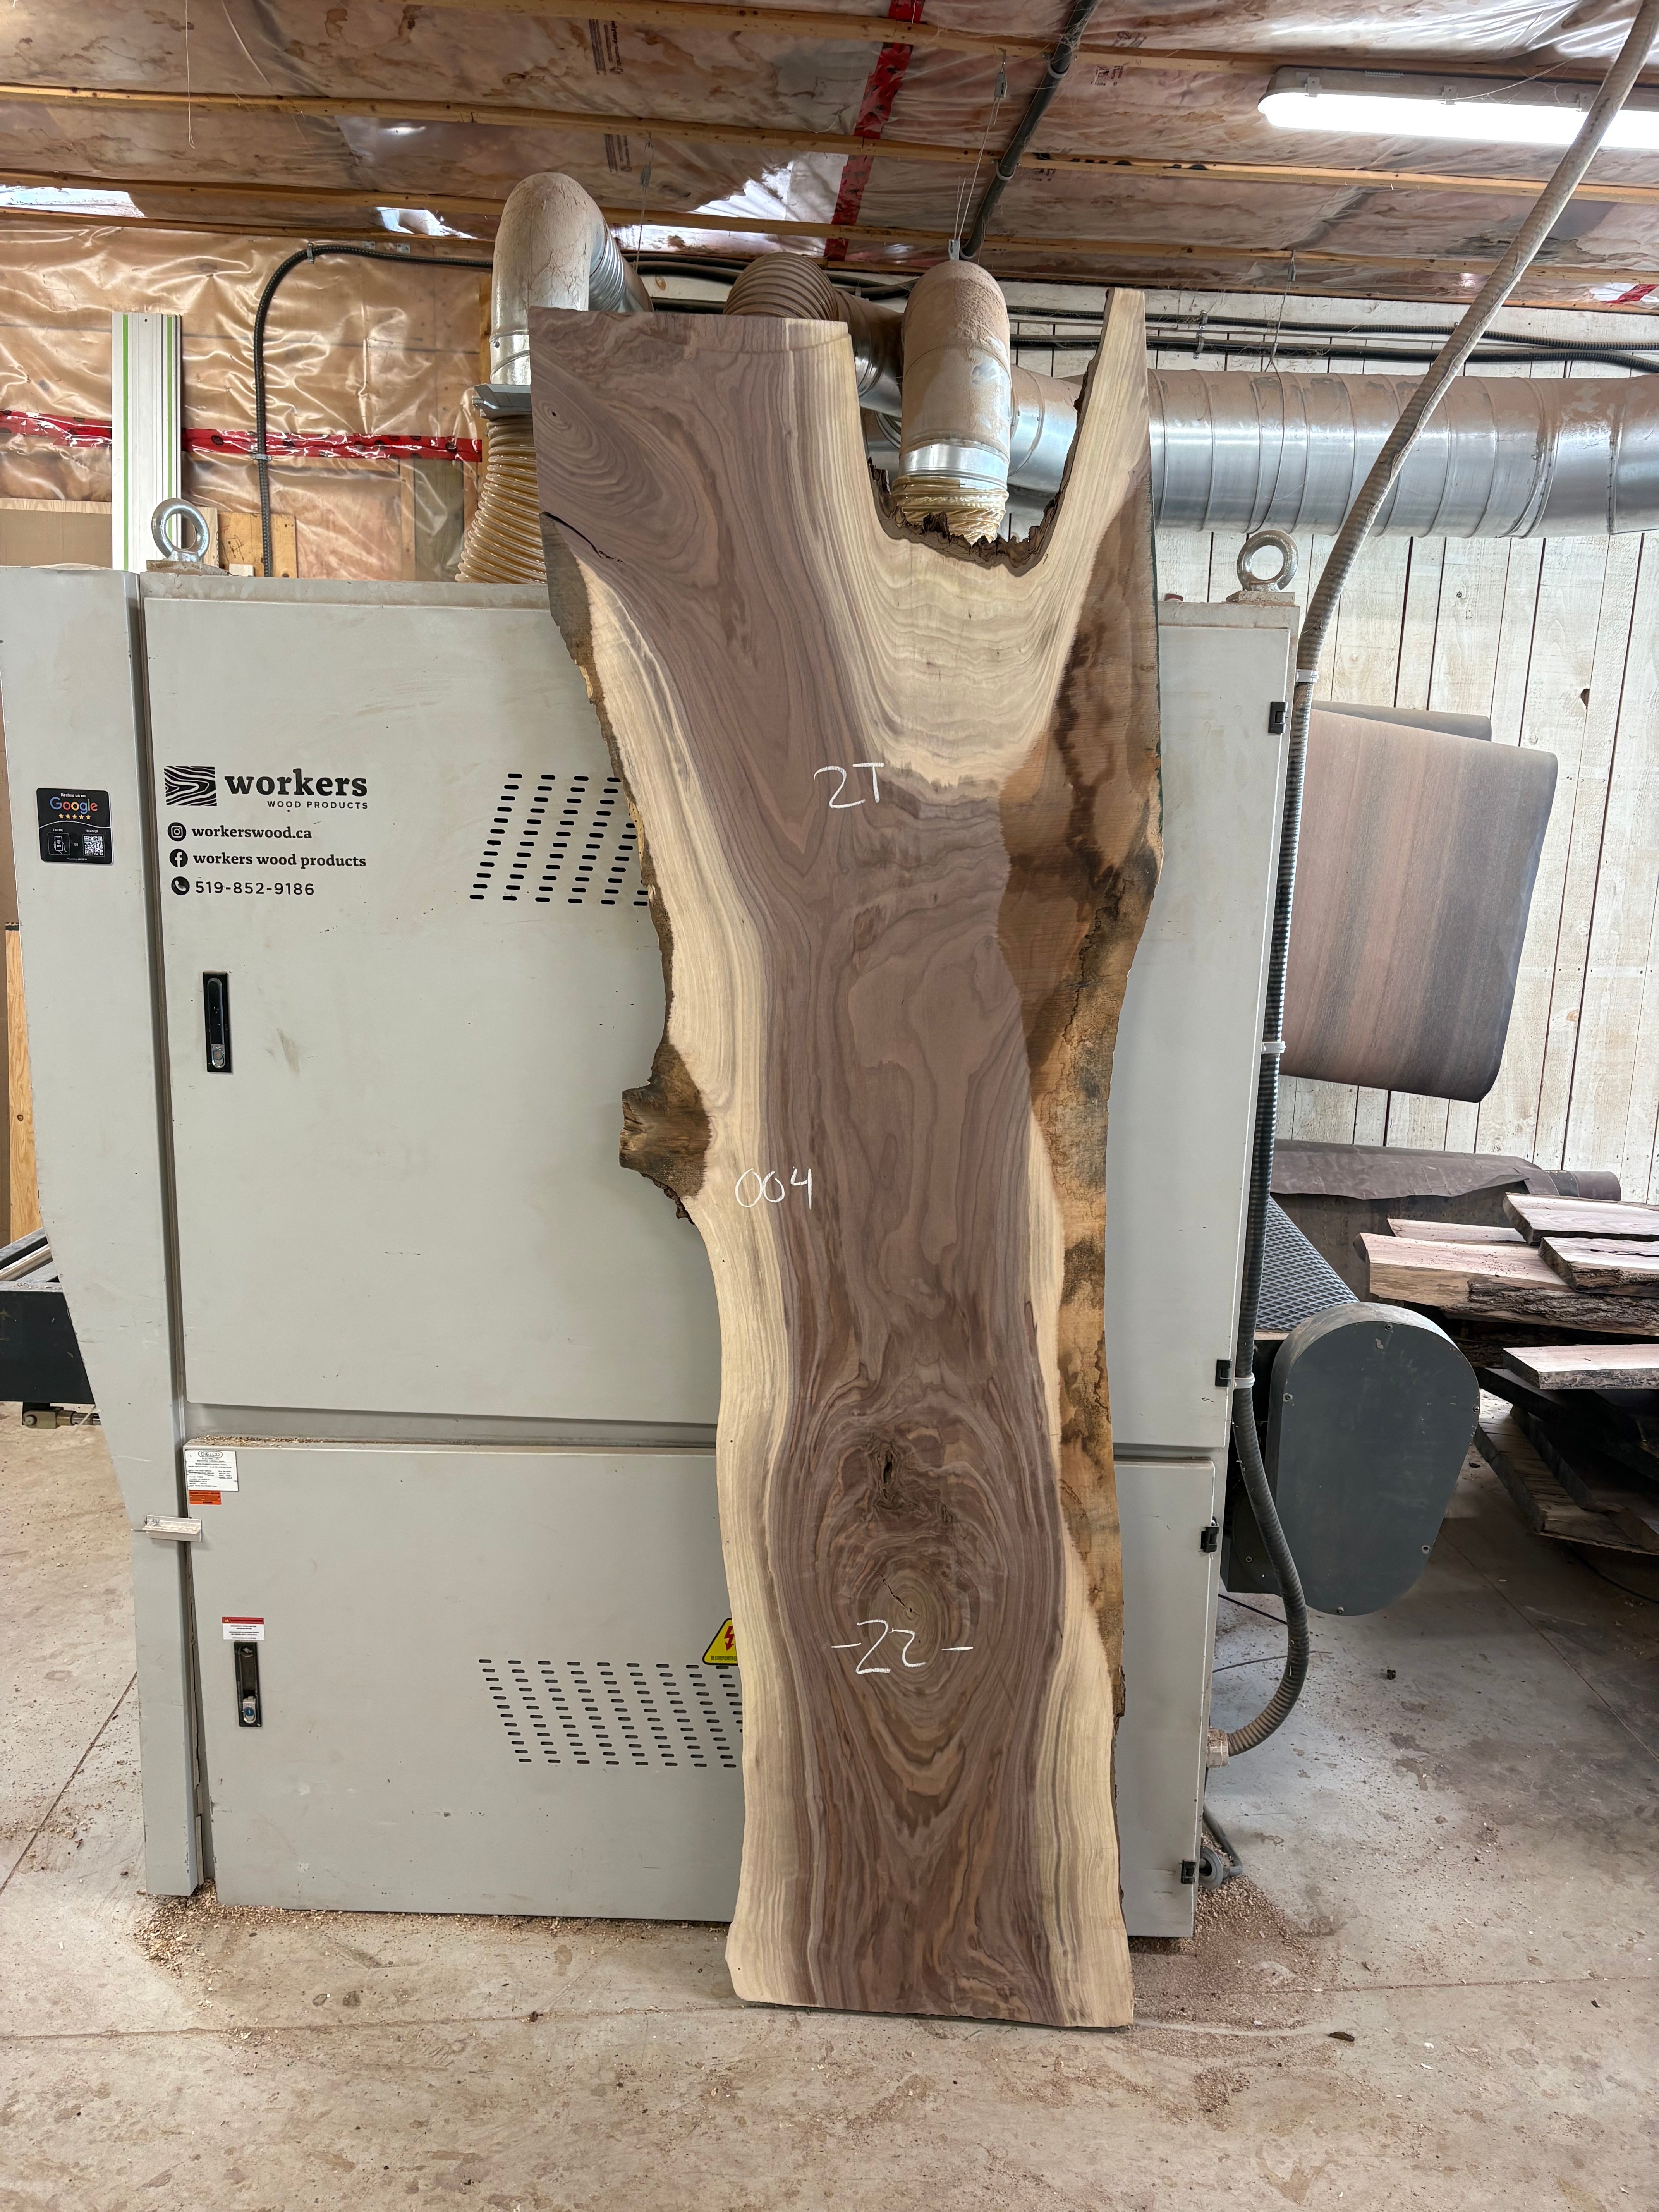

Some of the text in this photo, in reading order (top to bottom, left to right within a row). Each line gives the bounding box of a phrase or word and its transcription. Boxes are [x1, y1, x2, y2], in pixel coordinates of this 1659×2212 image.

[224, 768, 367, 797] workers
[814, 762, 885, 809] 2T
[50, 797, 98, 814] Google
[191, 825, 312, 839] workerswood.ca
[193, 852, 366, 869] workers wood products
[196, 881, 314, 895] 519-852-9186
[735, 1166, 812, 1210] 004
